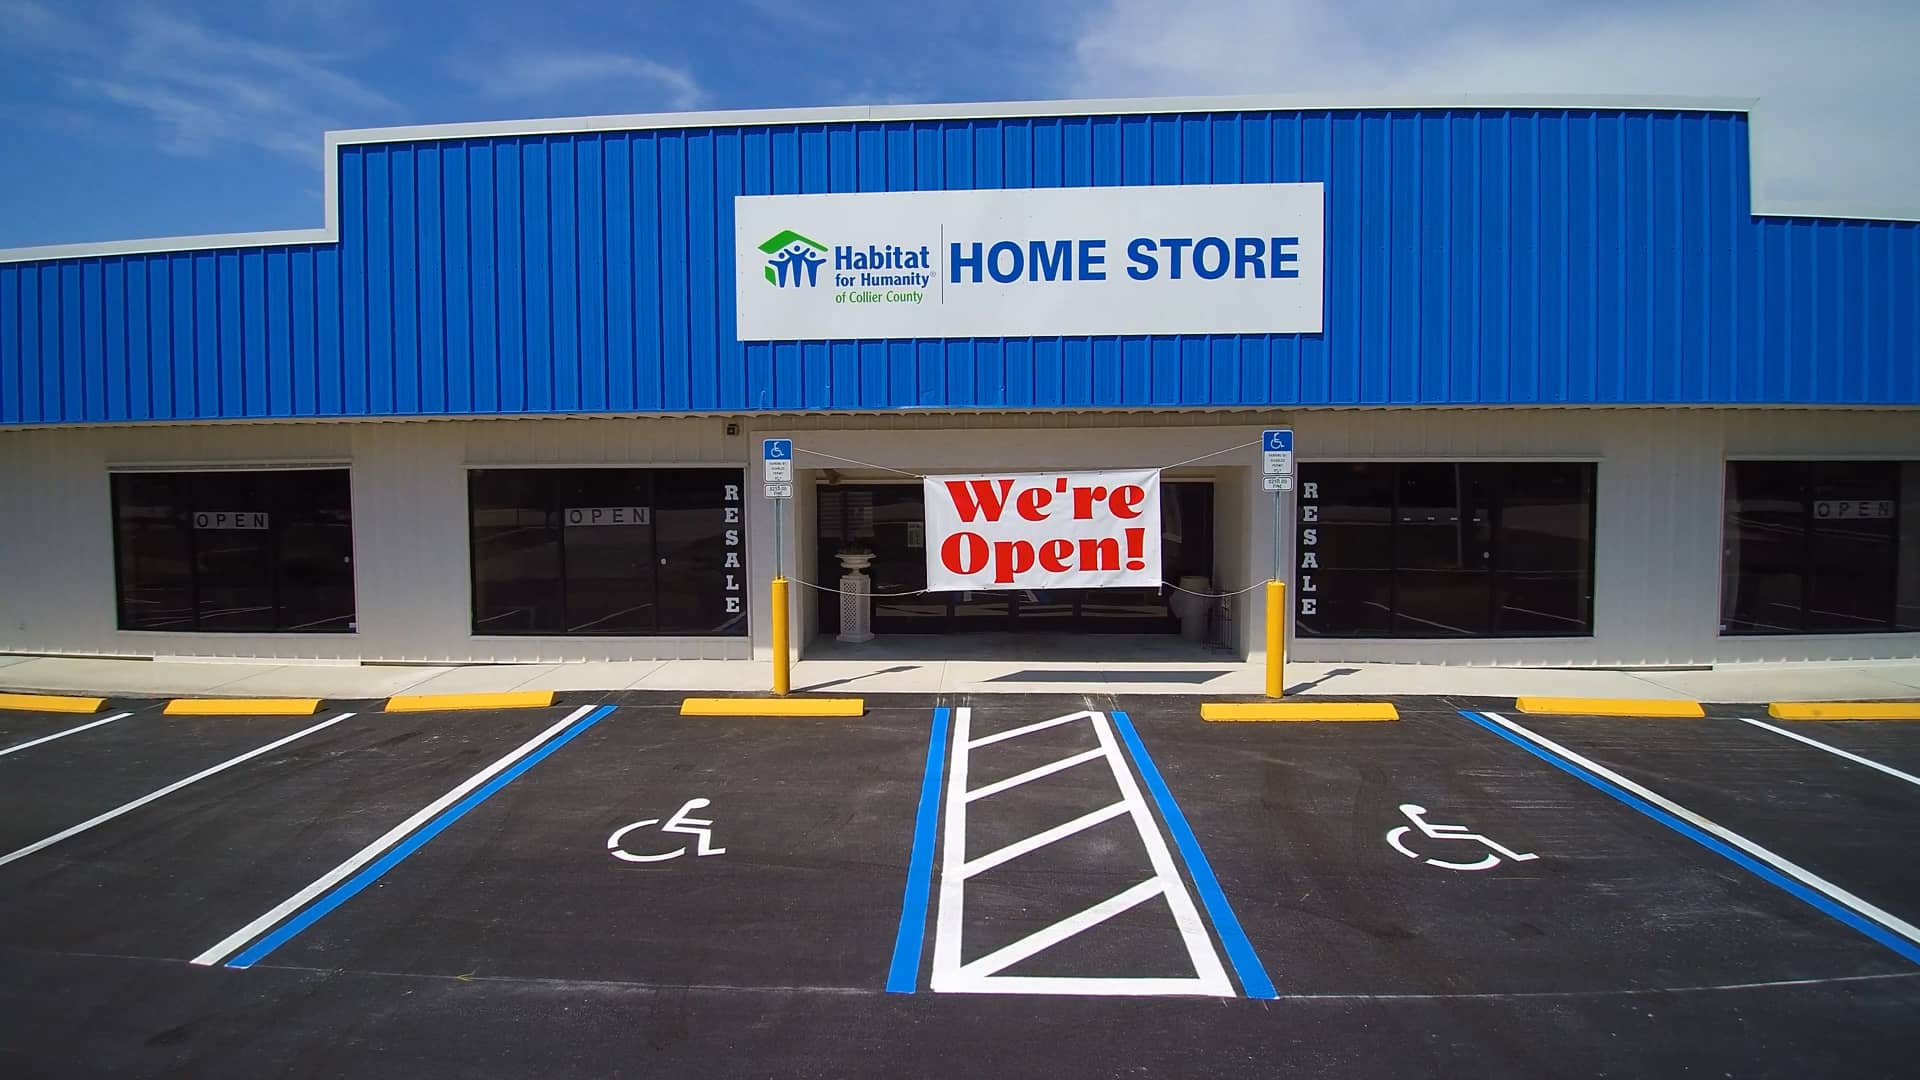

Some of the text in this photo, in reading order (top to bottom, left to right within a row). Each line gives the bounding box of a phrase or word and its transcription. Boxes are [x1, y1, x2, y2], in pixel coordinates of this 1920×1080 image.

[835, 245, 930, 270] Habitat
[949, 237, 1299, 284] HOME STORE
[835, 273, 856, 287] for
[835, 290, 923, 304] of Collier County
[944, 477, 1145, 523] We're
[1817, 502, 1889, 518] OPEN
[197, 514, 264, 528] OPEN
[569, 508, 645, 524] OPEN
[724, 484, 741, 613] RESALE
[941, 527, 1146, 584] Open!
[1301, 482, 1319, 615] RESALE
